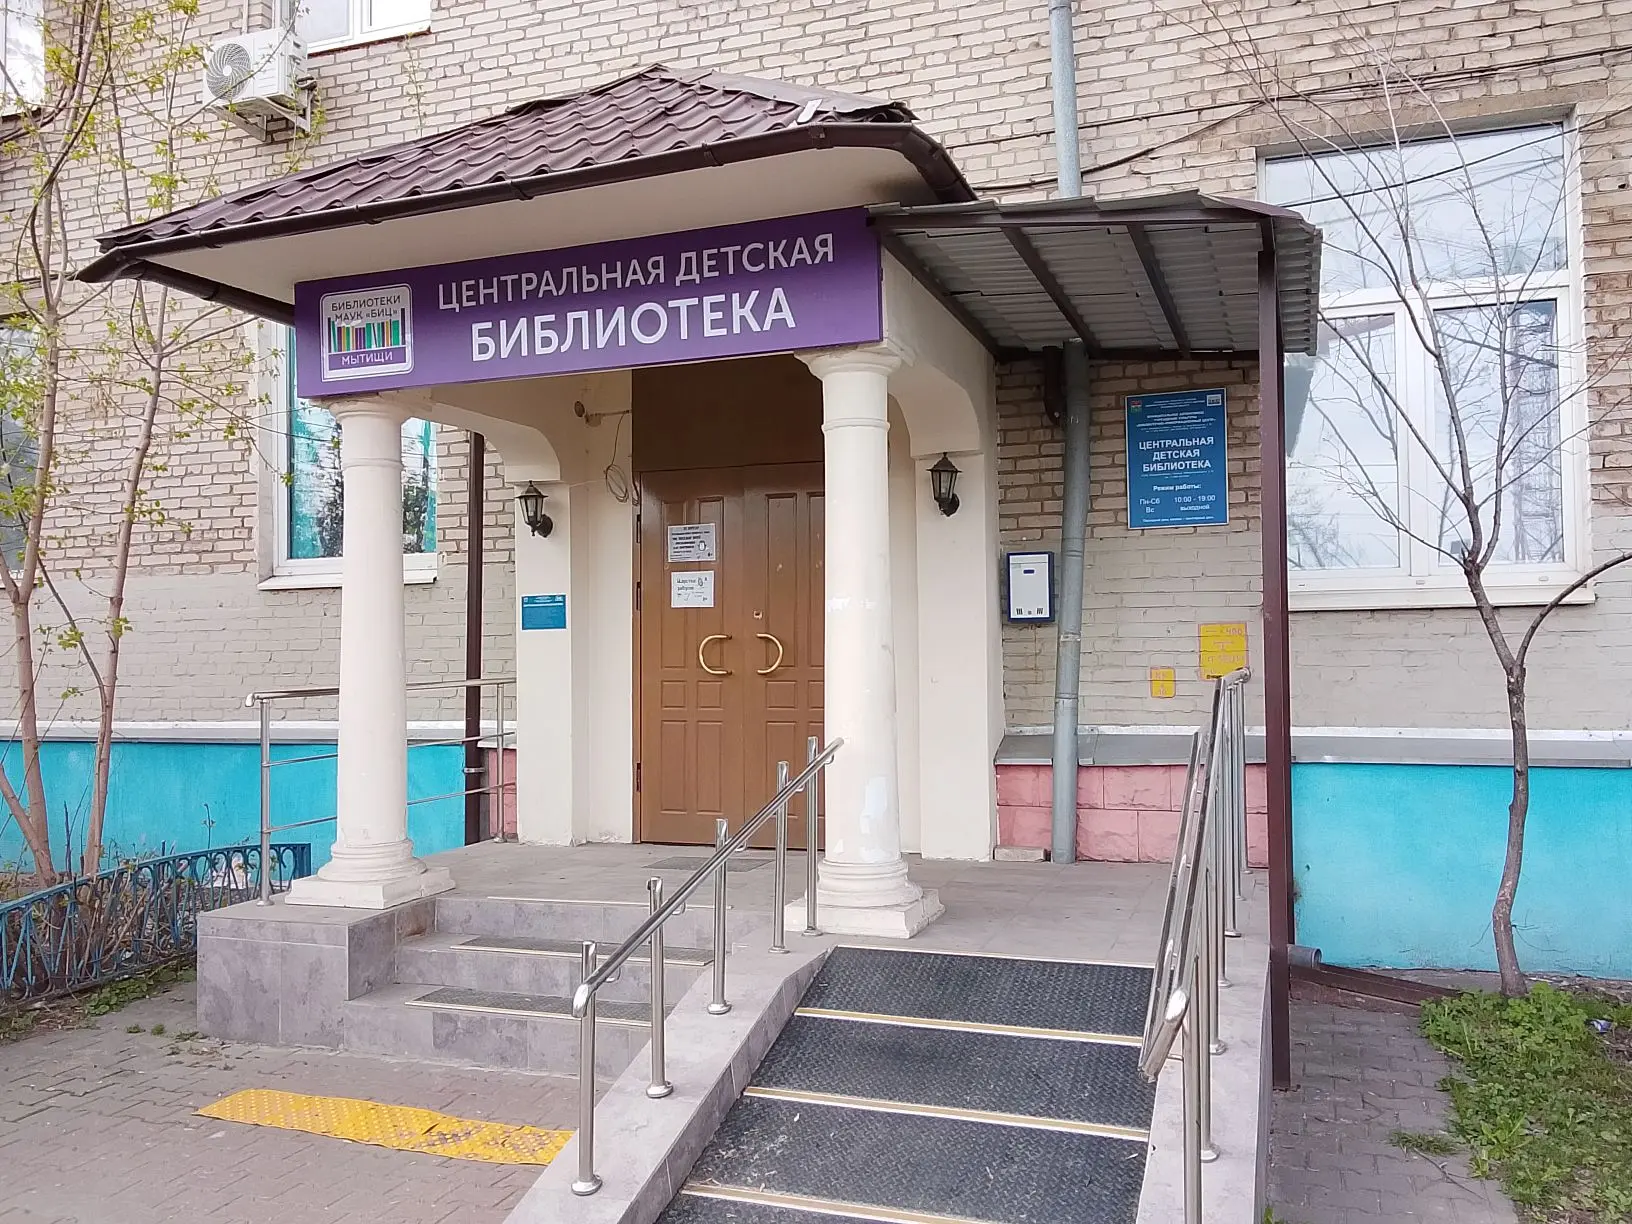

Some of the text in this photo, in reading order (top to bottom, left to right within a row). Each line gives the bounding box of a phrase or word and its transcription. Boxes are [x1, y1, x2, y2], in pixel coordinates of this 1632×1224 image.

[438, 233, 834, 311] ЦЕНТРАЛЬНАЯ ДЕТСКАЯ
[331, 295, 401, 311] БИБЛИОТЕКИ
[335, 308, 398, 321] МАУК «БИЦ»
[471, 287, 796, 362] БИБЛИОТЕКА
[341, 351, 393, 365] МЫТИЩИ
[1138, 436, 1214, 450] ЦЕНТРАЛЬНАЯ
[1152, 449, 1200, 462] ДЕТСКАЯ
[1142, 459, 1211, 472] БИБЛИОТЕКА
[1145, 506, 1155, 514] Вс
